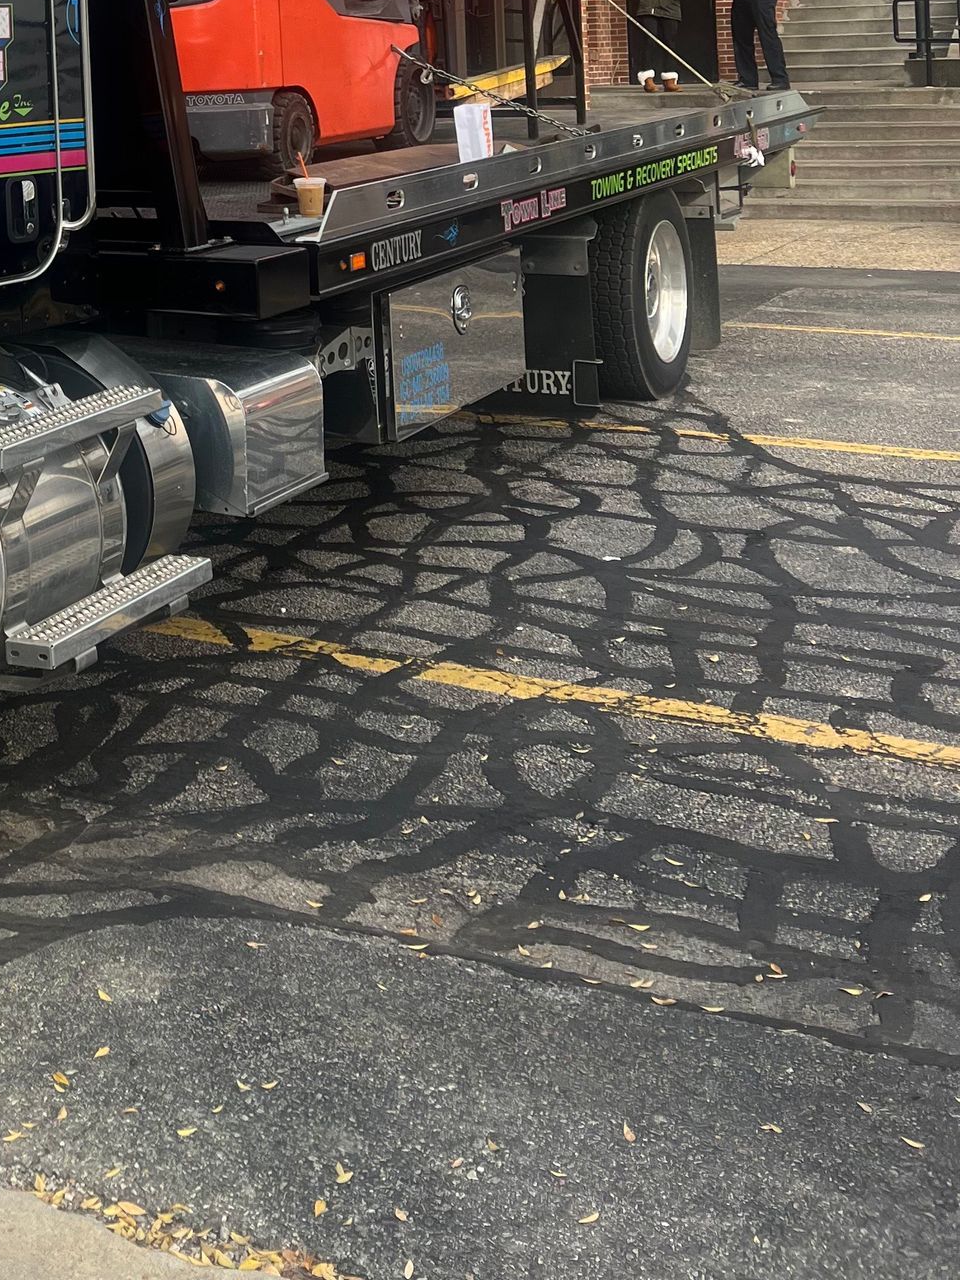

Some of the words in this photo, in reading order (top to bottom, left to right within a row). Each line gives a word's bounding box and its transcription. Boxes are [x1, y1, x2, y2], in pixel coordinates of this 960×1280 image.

[185, 93, 245, 107] TOYOTA
[591, 170, 625, 200] TOWING
[626, 169, 634, 190] &
[635, 157, 676, 187] RECOVERY
[676, 145, 718, 174] SPECIALISTS
[500, 197, 539, 233] TOWN
[371, 229, 422, 272] CENTURY
